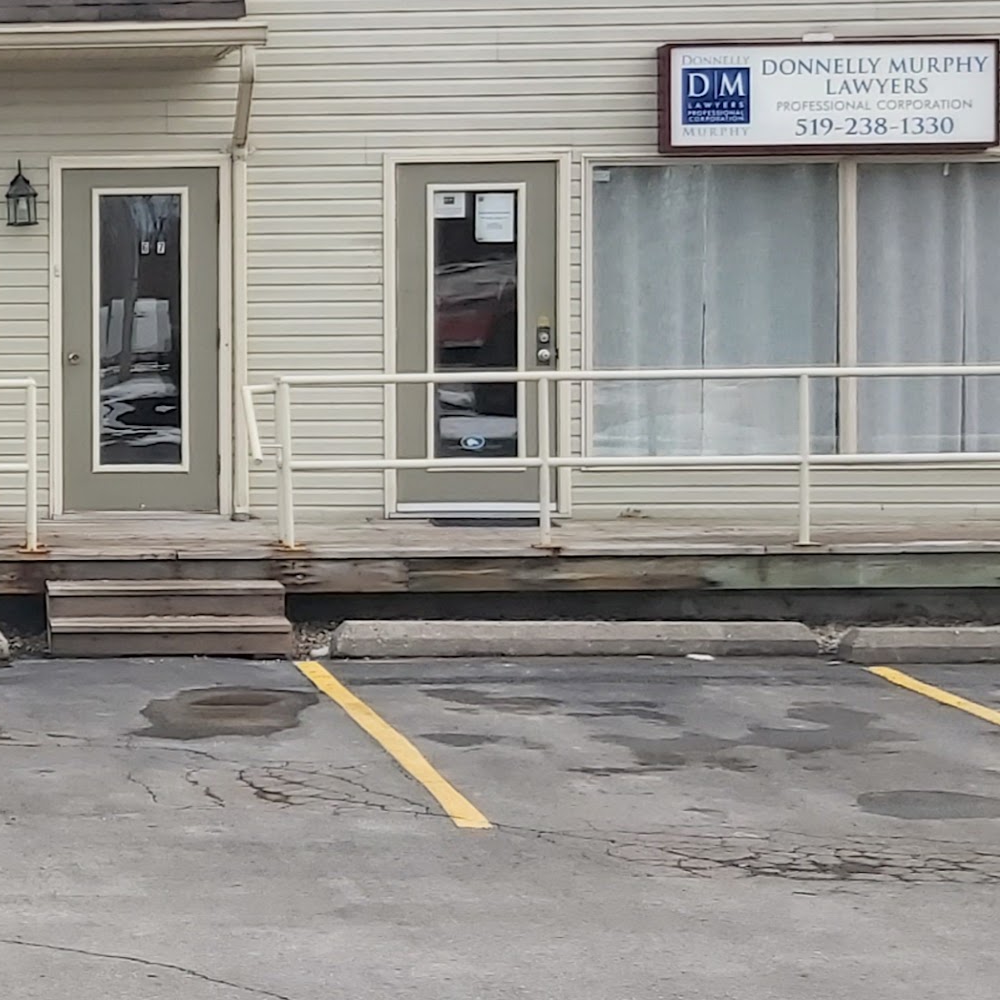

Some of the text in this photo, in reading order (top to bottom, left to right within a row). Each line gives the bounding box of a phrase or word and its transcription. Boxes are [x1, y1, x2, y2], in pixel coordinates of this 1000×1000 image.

[681, 55, 750, 66] DONNELLY
[761, 56, 989, 76] DONNELLY MURPHY
[825, 78, 929, 95] LAWYERS
[687, 101, 745, 109] LAWYERS
[776, 99, 973, 112] PROFESSIONAL CORPORATION
[682, 127, 750, 137] MURPHY
[795, 117, 954, 136] 519-238-1330
